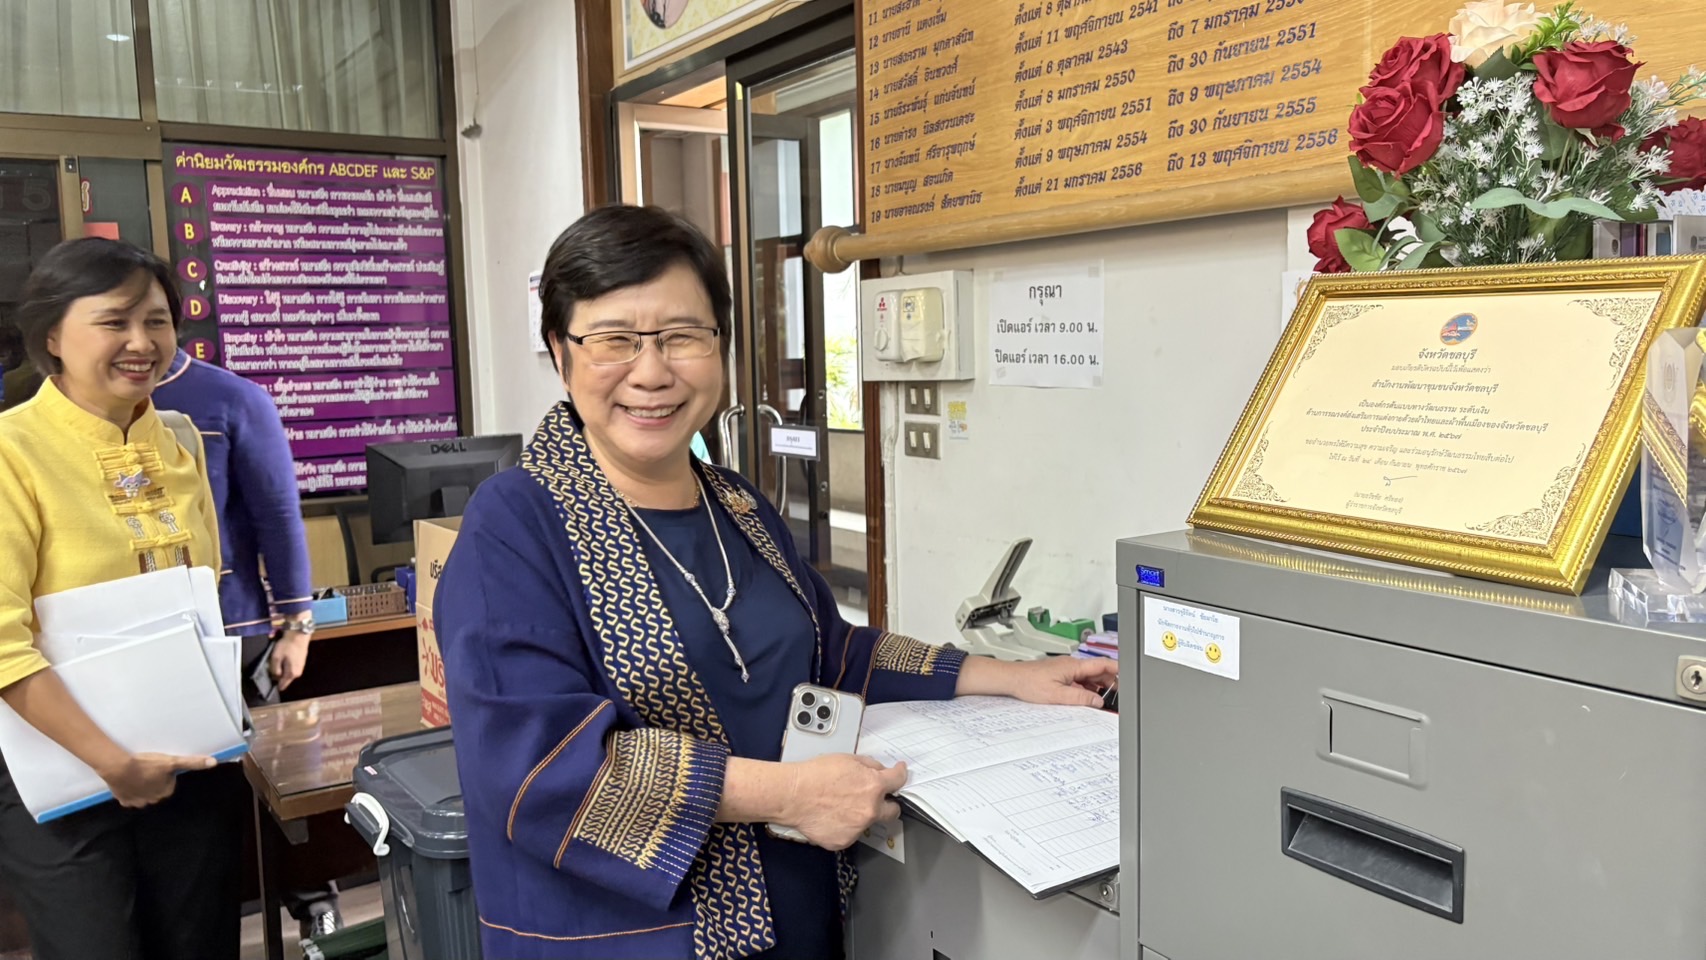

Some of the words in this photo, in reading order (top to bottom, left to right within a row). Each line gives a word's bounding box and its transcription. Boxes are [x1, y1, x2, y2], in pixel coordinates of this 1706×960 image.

[869, 35, 878, 50] 12
[870, 61, 879, 75] 13
[1014, 2, 1042, 26] ตั้งแต่
[1046, 3, 1052, 15] 8
[870, 88, 878, 101] 14
[1014, 31, 1042, 54] ตั้งแต่
[1047, 30, 1058, 44] 11
[1064, 10, 1124, 40] พฤศจิกายน
[1129, 0, 1158, 20] 2541
[870, 113, 879, 125] 15
[1014, 60, 1042, 83] ตั้งแต่
[1046, 61, 1053, 74] 6
[1057, 50, 1093, 76] ตุลาคม
[1098, 39, 1128, 60] 2543
[1168, 20, 1184, 41] ถึง
[1191, 19, 1199, 34] 7
[1204, 2, 1260, 31] มกราคม
[871, 137, 880, 151] 16
[1014, 89, 1042, 112] ตั้งแต่
[1046, 90, 1053, 104] 8
[1058, 79, 1100, 101] มกราคม
[1104, 68, 1136, 89] 2550
[1167, 54, 1184, 74] ถึง
[1189, 51, 1208, 68] 30
[1213, 38, 1270, 62] กันยายน
[1276, 22, 1317, 47] 2551
[871, 161, 881, 174] 17
[1014, 118, 1042, 140] ตั้งแต่
[1046, 120, 1052, 133] 3
[1058, 107, 1116, 132] พฤศจิกายน
[1121, 97, 1152, 117] 2551
[1168, 88, 1184, 106] ถึง
[1190, 86, 1198, 102] 9
[1204, 70, 1275, 100] พฤษภาคม
[1280, 58, 1322, 82] 2554
[871, 185, 880, 198] 18
[1014, 146, 1042, 168] ตั้งแต่
[1046, 149, 1053, 162] 9
[1058, 138, 1111, 162] พฤษภาคม
[1116, 130, 1148, 148] 2554
[1168, 120, 1184, 139] ถึง
[1189, 118, 1207, 135] 30
[1213, 108, 1269, 130] กันยายน
[1275, 96, 1317, 119] 2555
[329, 165, 378, 178] ABCDEF
[382, 166, 407, 179] และ
[411, 166, 434, 179] S&P
[872, 210, 881, 223] 19
[1014, 176, 1042, 198] ตั้งแต่
[1046, 178, 1058, 192] 21
[1064, 170, 1107, 189] มกราคม
[1111, 162, 1143, 181] 2556
[1167, 153, 1184, 172] ถึง
[1190, 152, 1206, 168] 13
[1213, 138, 1289, 166] พฤศจิกายน
[1295, 128, 1338, 151] 2556
[180, 187, 192, 204] A
[184, 223, 195, 239] B
[187, 262, 198, 277] C
[1029, 284, 1062, 306] กรุณา
[190, 300, 202, 315] D
[996, 318, 1033, 334] เปิดแอร์
[1034, 321, 1056, 333] เวลา
[1059, 322, 1083, 333] 9.00
[1087, 322, 1098, 333] น.
[195, 343, 204, 359] E
[995, 348, 1027, 364] ปิดแอร์
[1028, 352, 1049, 364] เวลา
[1053, 354, 1084, 365] 16.00
[1089, 354, 1099, 366] น.
[1418, 348, 1478, 363] จังหวัดชลบุรี
[1372, 379, 1498, 396] สำนักงานพัฒนาชุมชนจังหวัดชลบุรี
[430, 442, 466, 454] DELL
